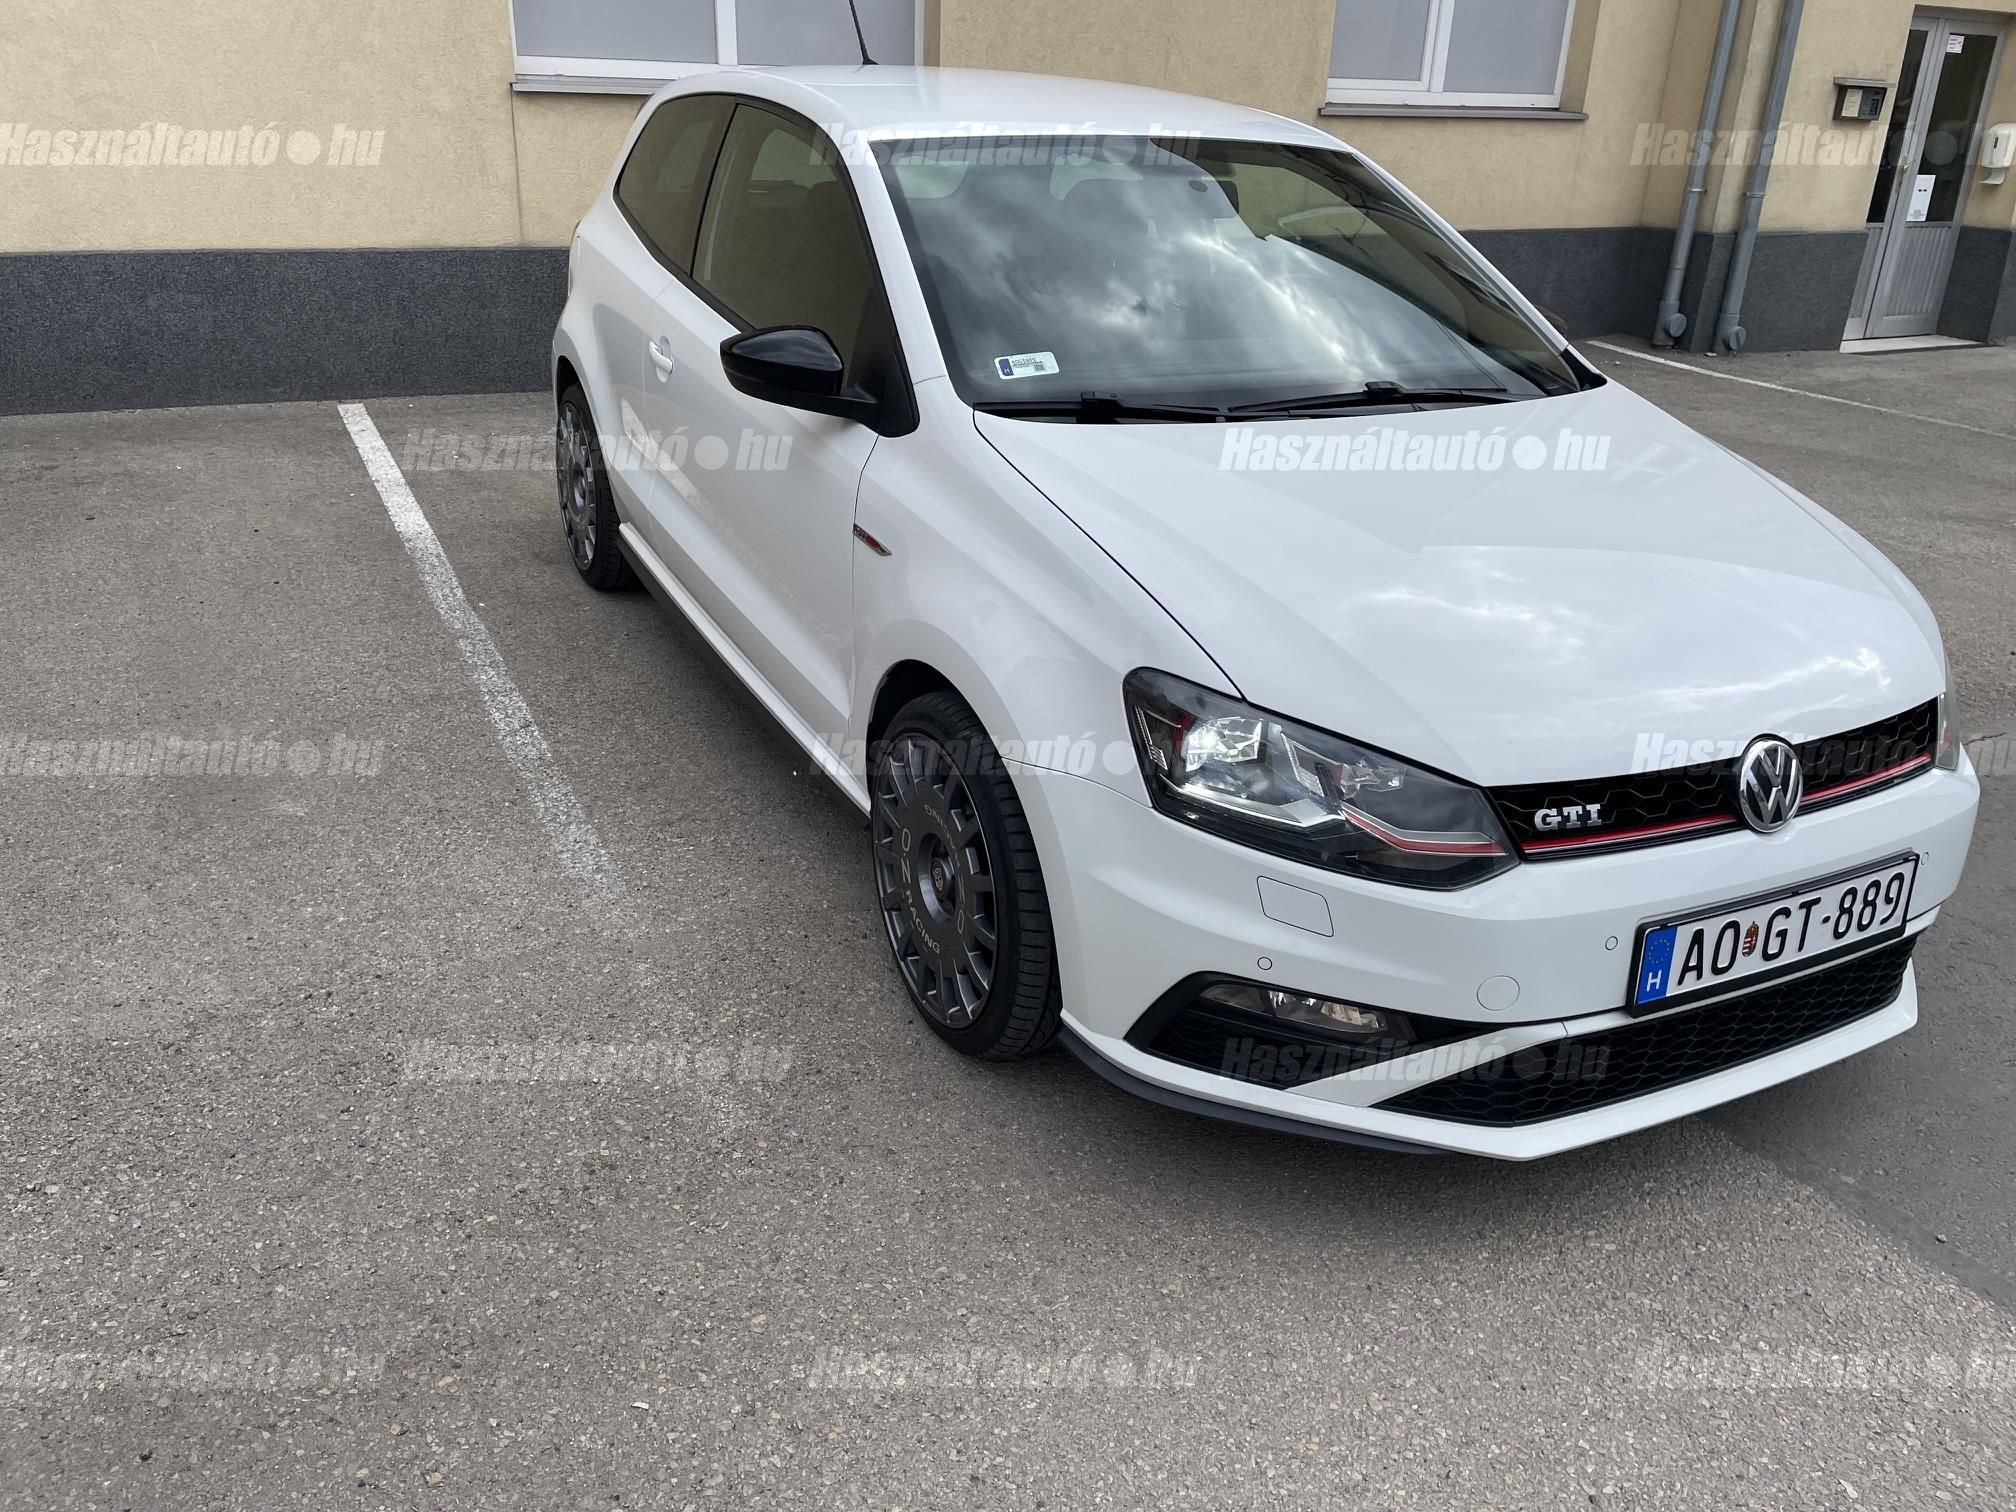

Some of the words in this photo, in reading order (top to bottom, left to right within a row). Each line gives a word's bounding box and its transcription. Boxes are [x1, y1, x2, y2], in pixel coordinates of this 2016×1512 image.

[1534, 804, 1602, 832] GTI
[905, 889, 941, 954] RACING
[1677, 919, 1742, 986] AO
[1761, 871, 1905, 962] GT-889
[1646, 969, 1663, 992] H
